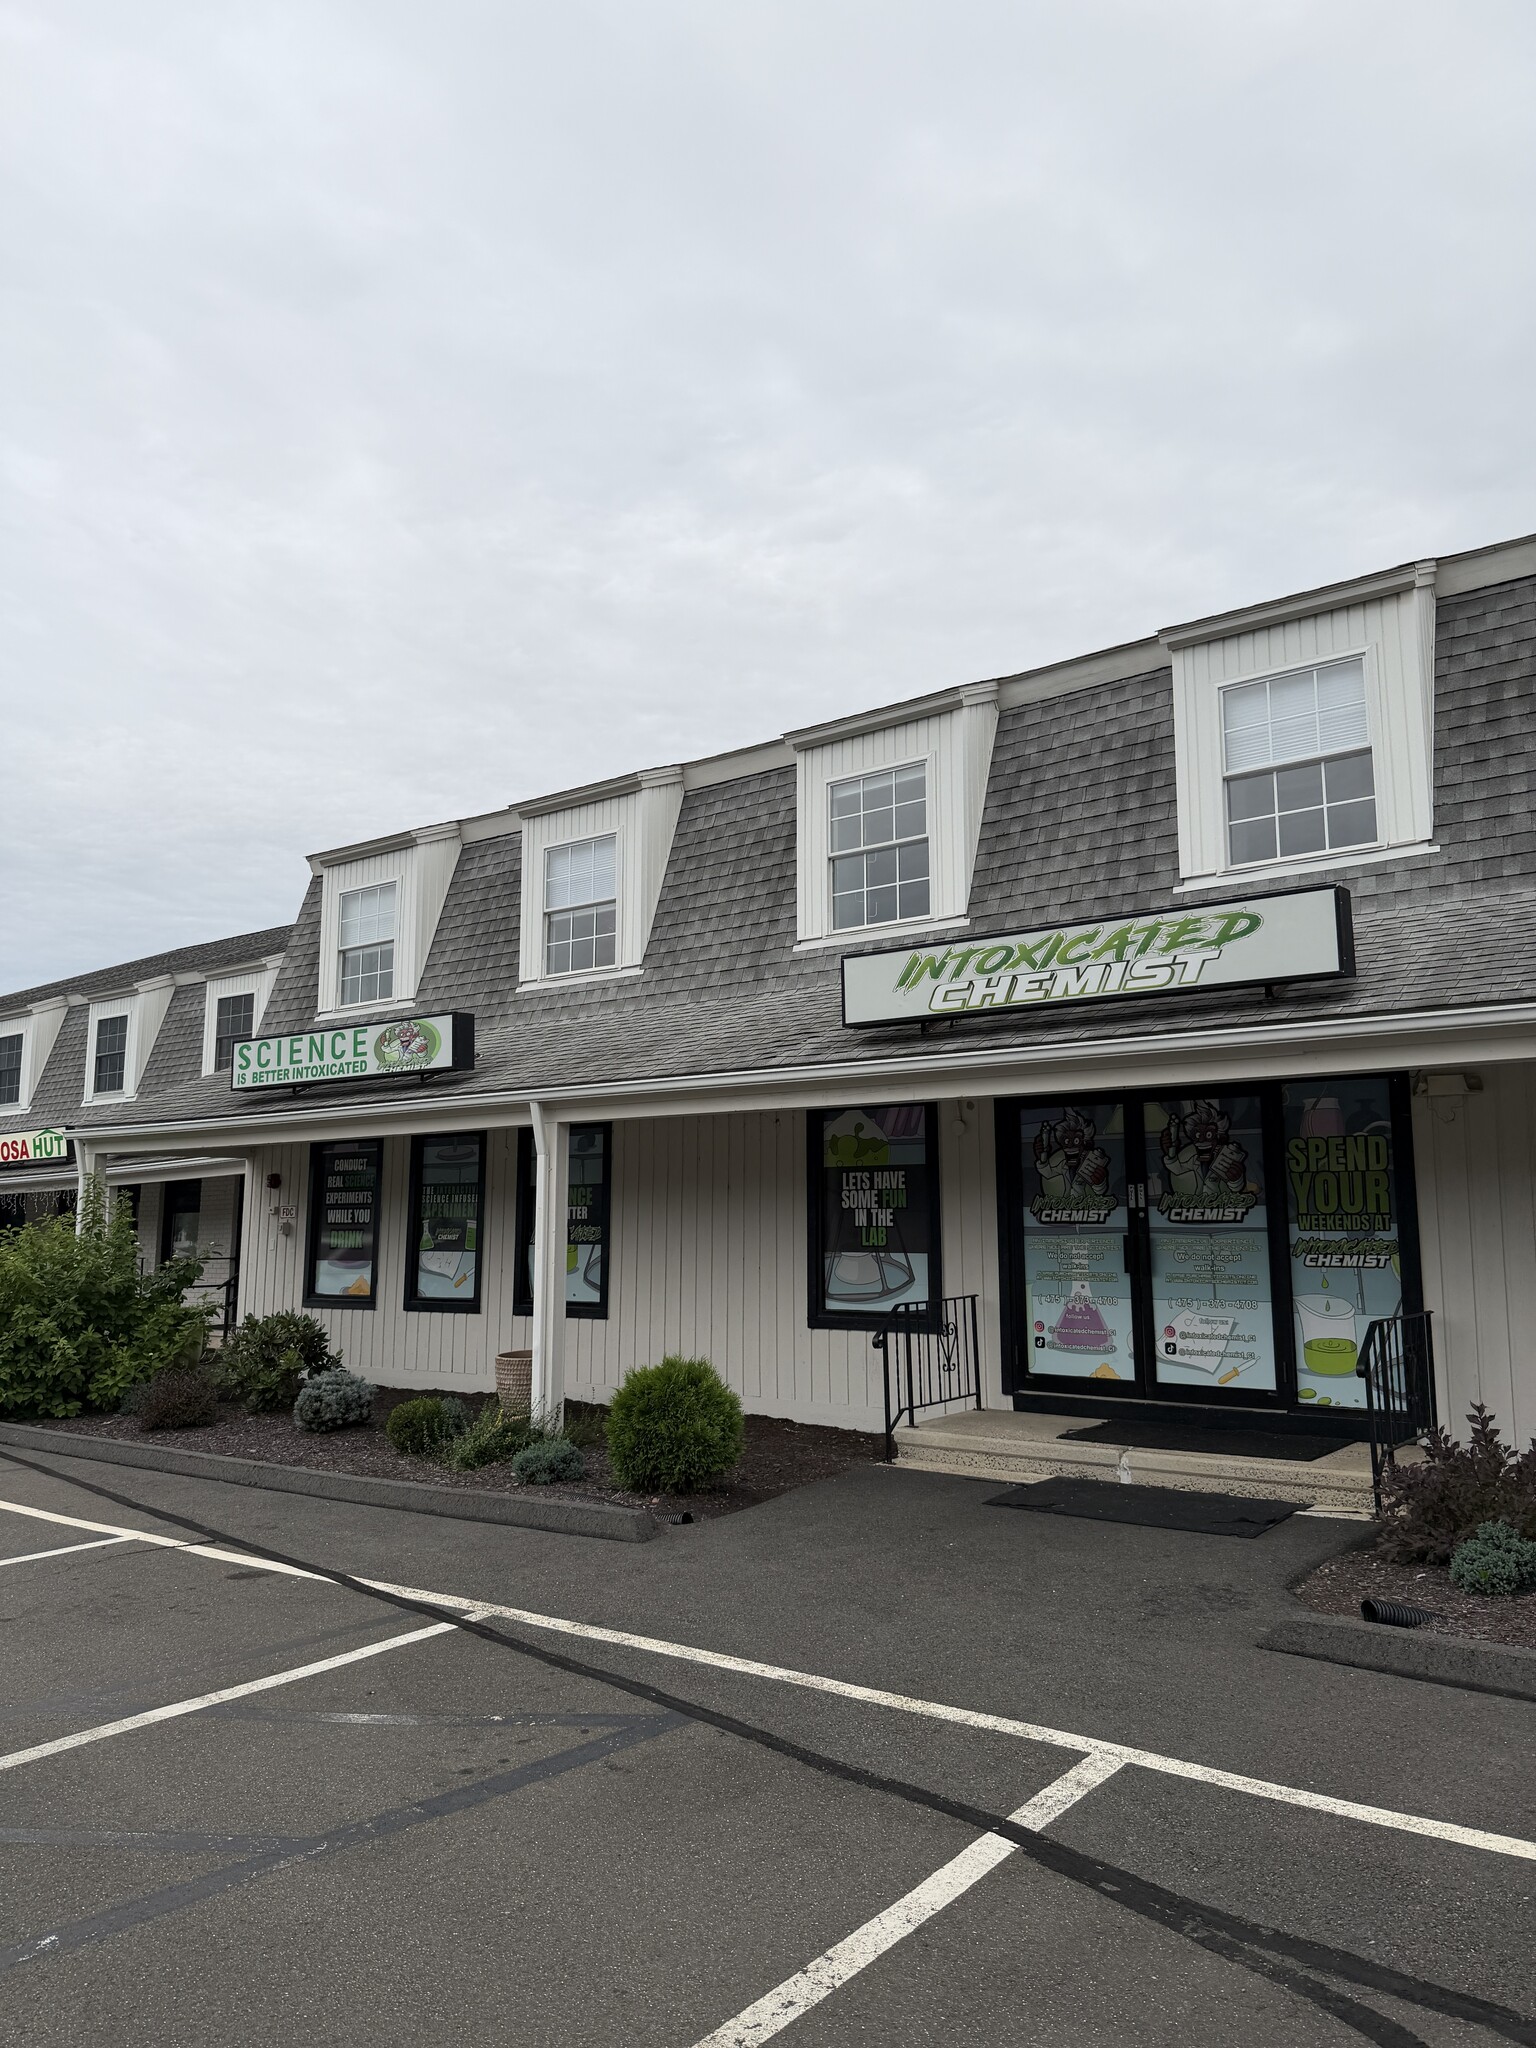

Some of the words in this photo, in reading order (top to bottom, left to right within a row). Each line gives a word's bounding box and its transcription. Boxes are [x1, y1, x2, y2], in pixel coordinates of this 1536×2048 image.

[892, 907, 1264, 993] INTOXICATED
[929, 948, 1221, 1012] CHEMIST
[238, 1028, 368, 1070] SCIENCE
[238, 1072, 246, 1084] IS
[252, 1068, 290, 1084] BETTER
[292, 1060, 368, 1080] INTOXICATED
[381, 1063, 429, 1073] CHEMIST
[0, 1139, 30, 1161] OSA
[33, 1136, 64, 1158] HUT
[1288, 1136, 1388, 1172] SPEND
[334, 1158, 368, 1172] CONDUCT
[328, 1176, 344, 1188] REAL
[344, 1174, 374, 1187] SCIENCE
[843, 1172, 870, 1190] LETS
[874, 1171, 905, 1189] HAVE
[326, 1191, 373, 1204] EXPERIMENTS
[422, 1186, 434, 1194] THE
[422, 1194, 449, 1203] SCIENCE
[1290, 1171, 1390, 1214] YOUR
[842, 1190, 878, 1208] SOME
[882, 1190, 907, 1208] FUN
[1030, 1194, 1118, 1214] INTOXICATED
[1158, 1192, 1256, 1212] INTOXICATED
[282, 1208, 294, 1217] FDC
[327, 1209, 352, 1223] WHILE
[354, 1209, 371, 1223] YOU
[568, 1206, 588, 1220] TTER
[855, 1209, 867, 1226] IN
[871, 1209, 894, 1226] THE
[1041, 1210, 1108, 1222] CHEMIST
[1170, 1208, 1246, 1220] CHEMIST
[1298, 1215, 1370, 1230] WEEKENDS
[1374, 1215, 1391, 1230] AT
[330, 1230, 364, 1248] DRINK
[862, 1227, 887, 1246] LAB
[1293, 1237, 1399, 1257] INTOXICATED
[1305, 1255, 1390, 1267] CHEMIST
